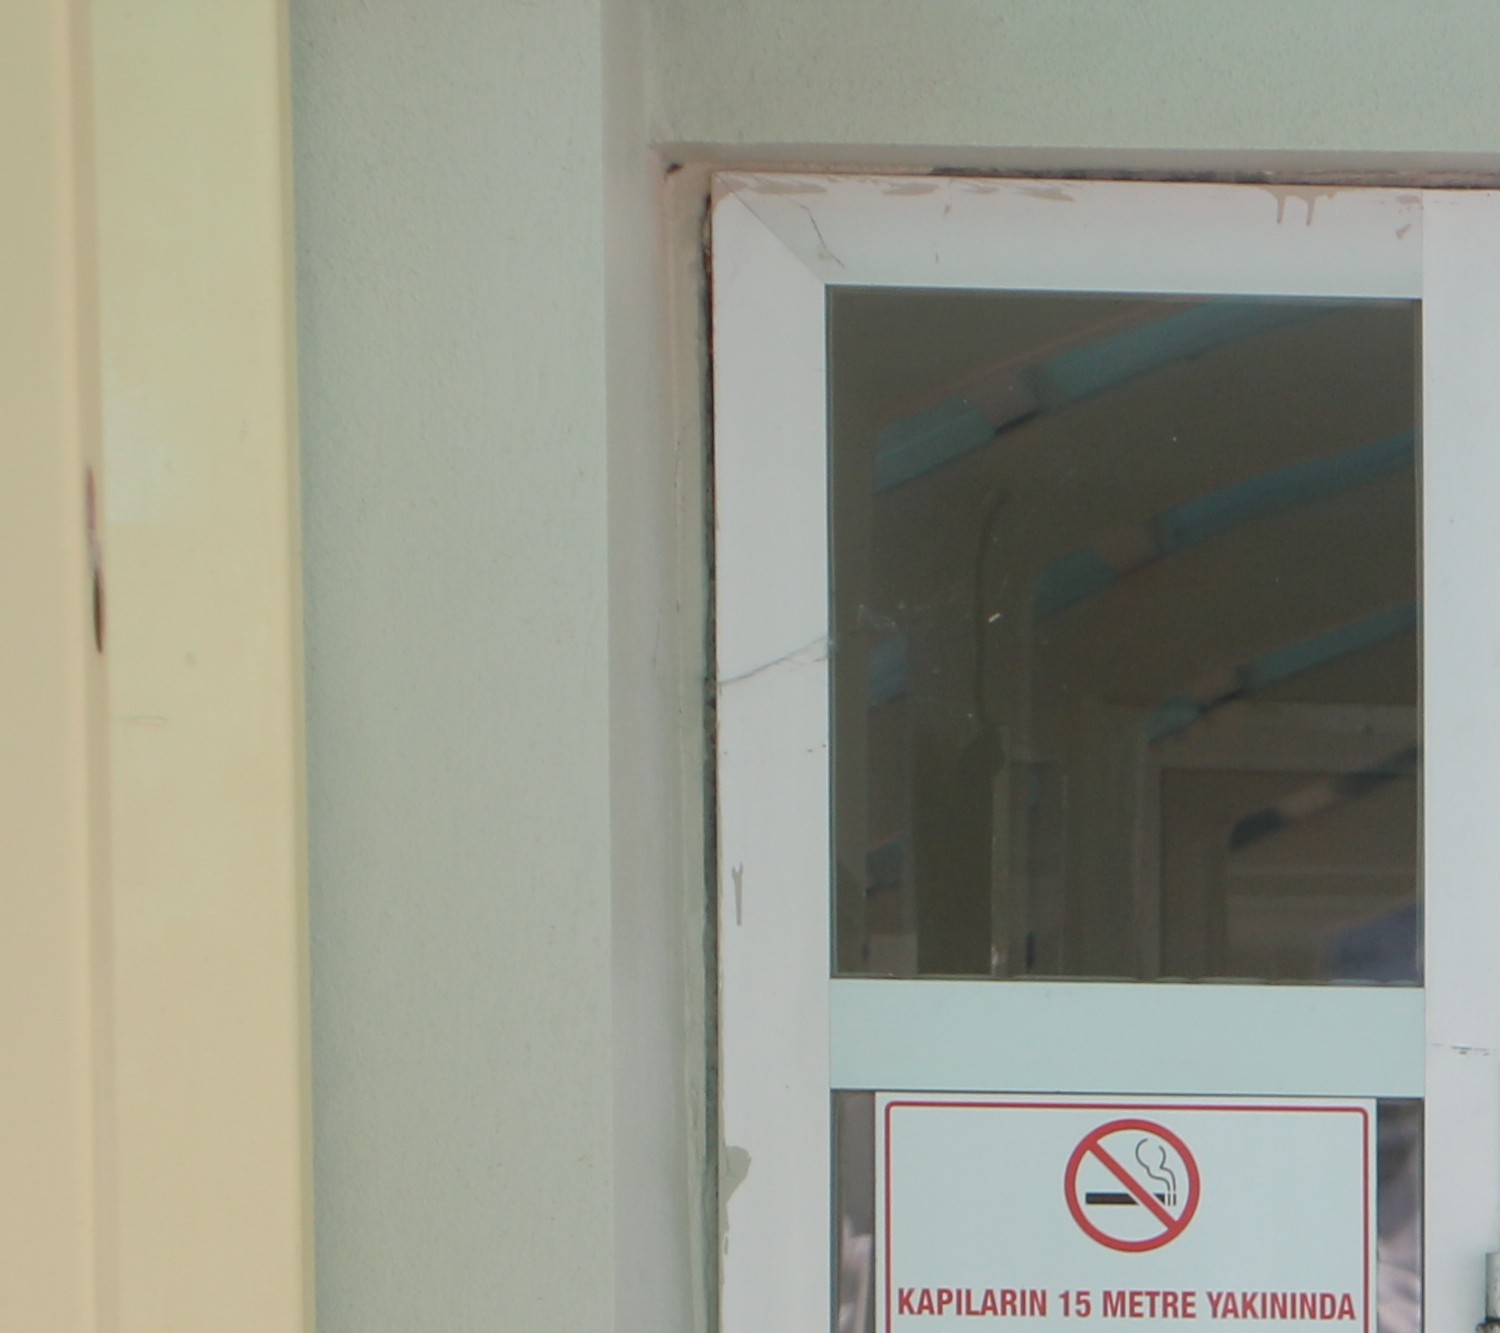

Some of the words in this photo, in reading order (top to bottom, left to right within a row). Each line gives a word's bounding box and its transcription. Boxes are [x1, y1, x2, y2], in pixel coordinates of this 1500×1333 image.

[898, 1288, 1047, 1317] KAPILARIN
[1058, 1289, 1091, 1318] 15
[1102, 1290, 1196, 1319] METRE
[1205, 1291, 1356, 1321] YAKININDA
